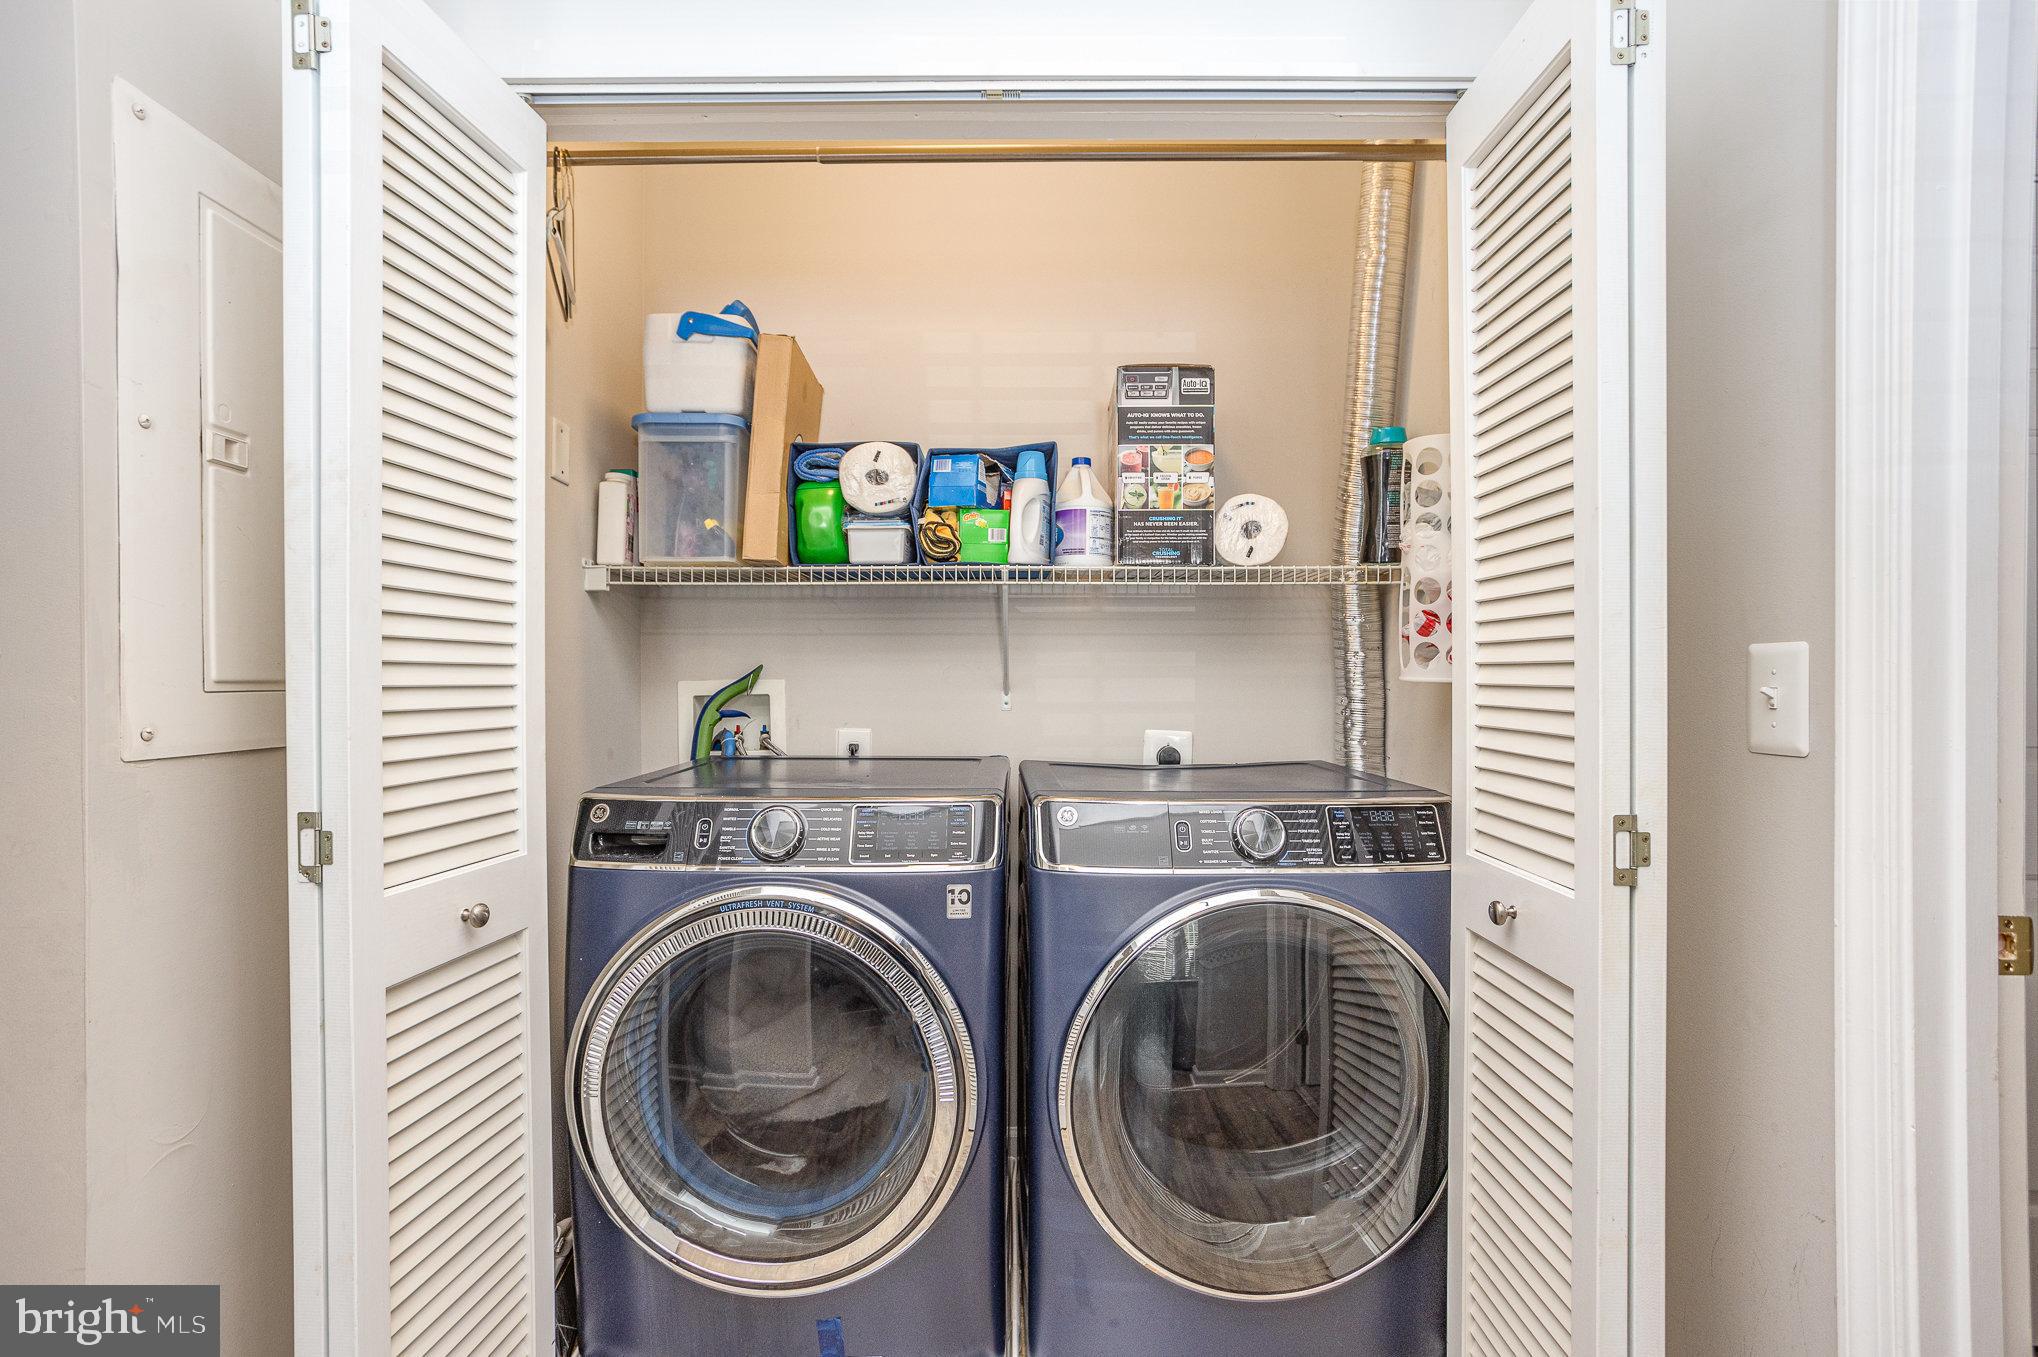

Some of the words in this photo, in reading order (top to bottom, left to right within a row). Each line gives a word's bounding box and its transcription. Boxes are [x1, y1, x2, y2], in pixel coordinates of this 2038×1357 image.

[948, 888, 970, 905] 10
[719, 900, 763, 913] ULTRAFRESH
[766, 900, 784, 908] VENT
[788, 902, 815, 913] SYSTEM
